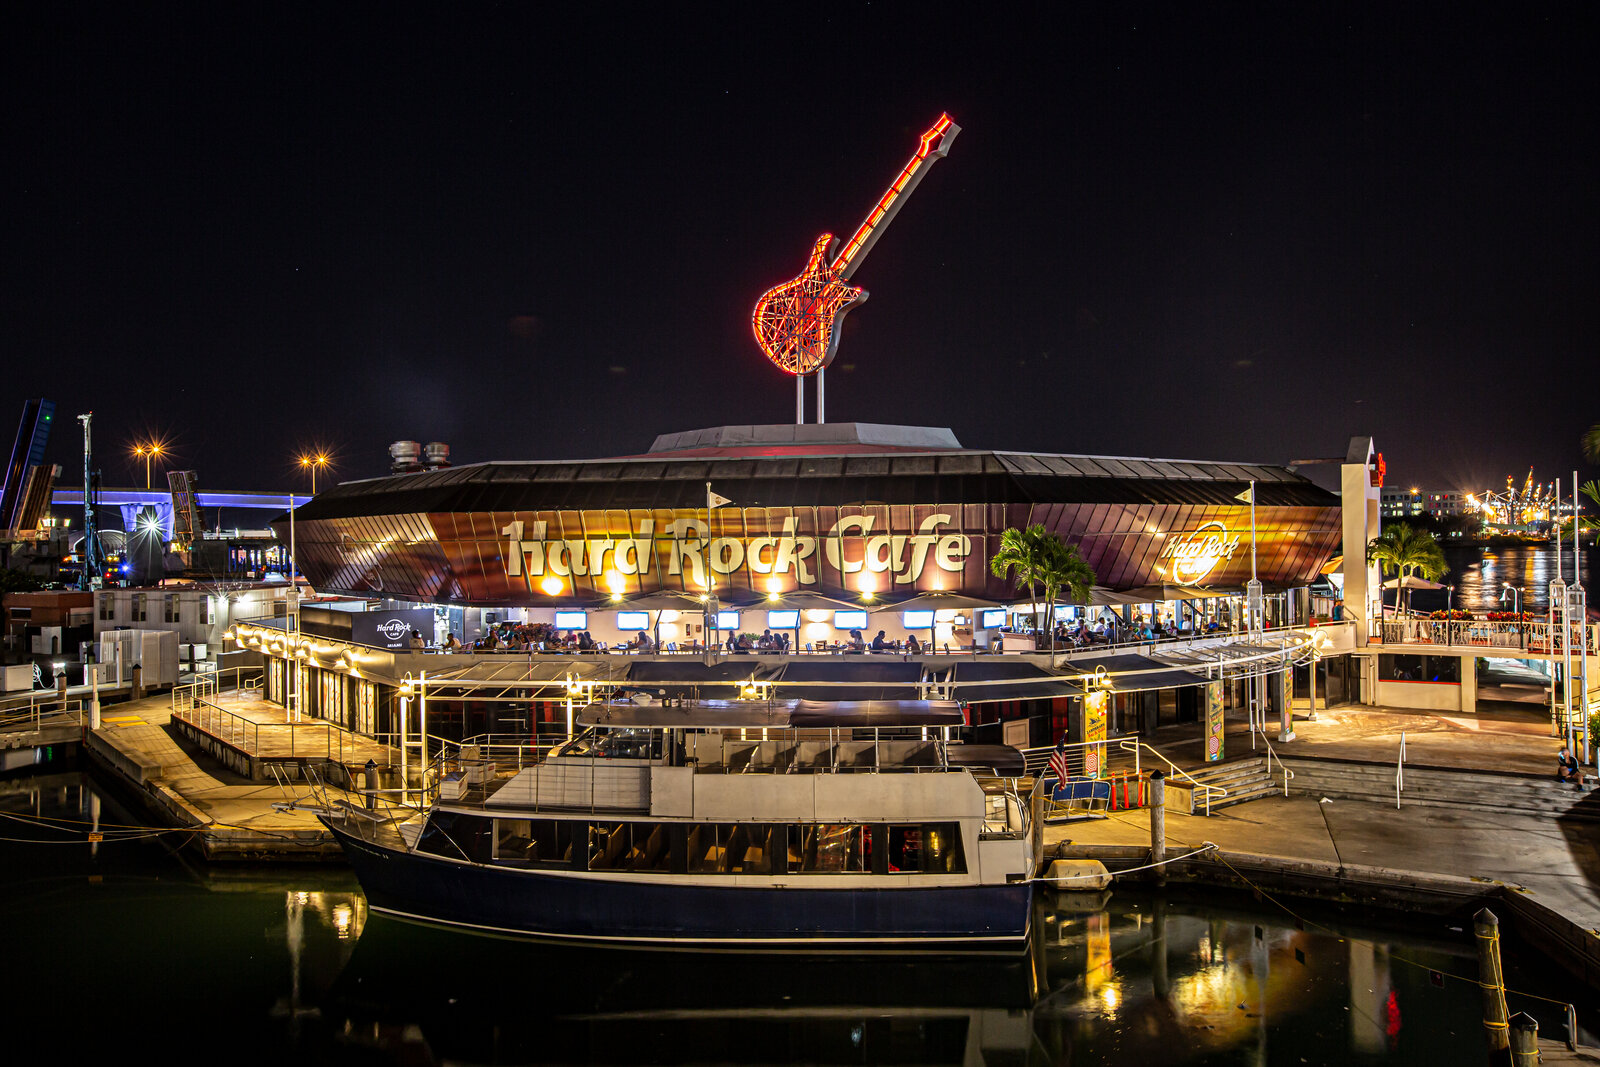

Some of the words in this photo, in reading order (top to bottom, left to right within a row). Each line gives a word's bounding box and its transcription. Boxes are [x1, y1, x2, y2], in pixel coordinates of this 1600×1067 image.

[502, 519, 655, 576] Hard
[665, 517, 816, 587] Rock
[826, 514, 971, 584] Cafe
[1161, 535, 1208, 558] Hard
[1203, 535, 1240, 561] Rock
[377, 624, 394, 632] Hard
[395, 623, 411, 632] Rock
